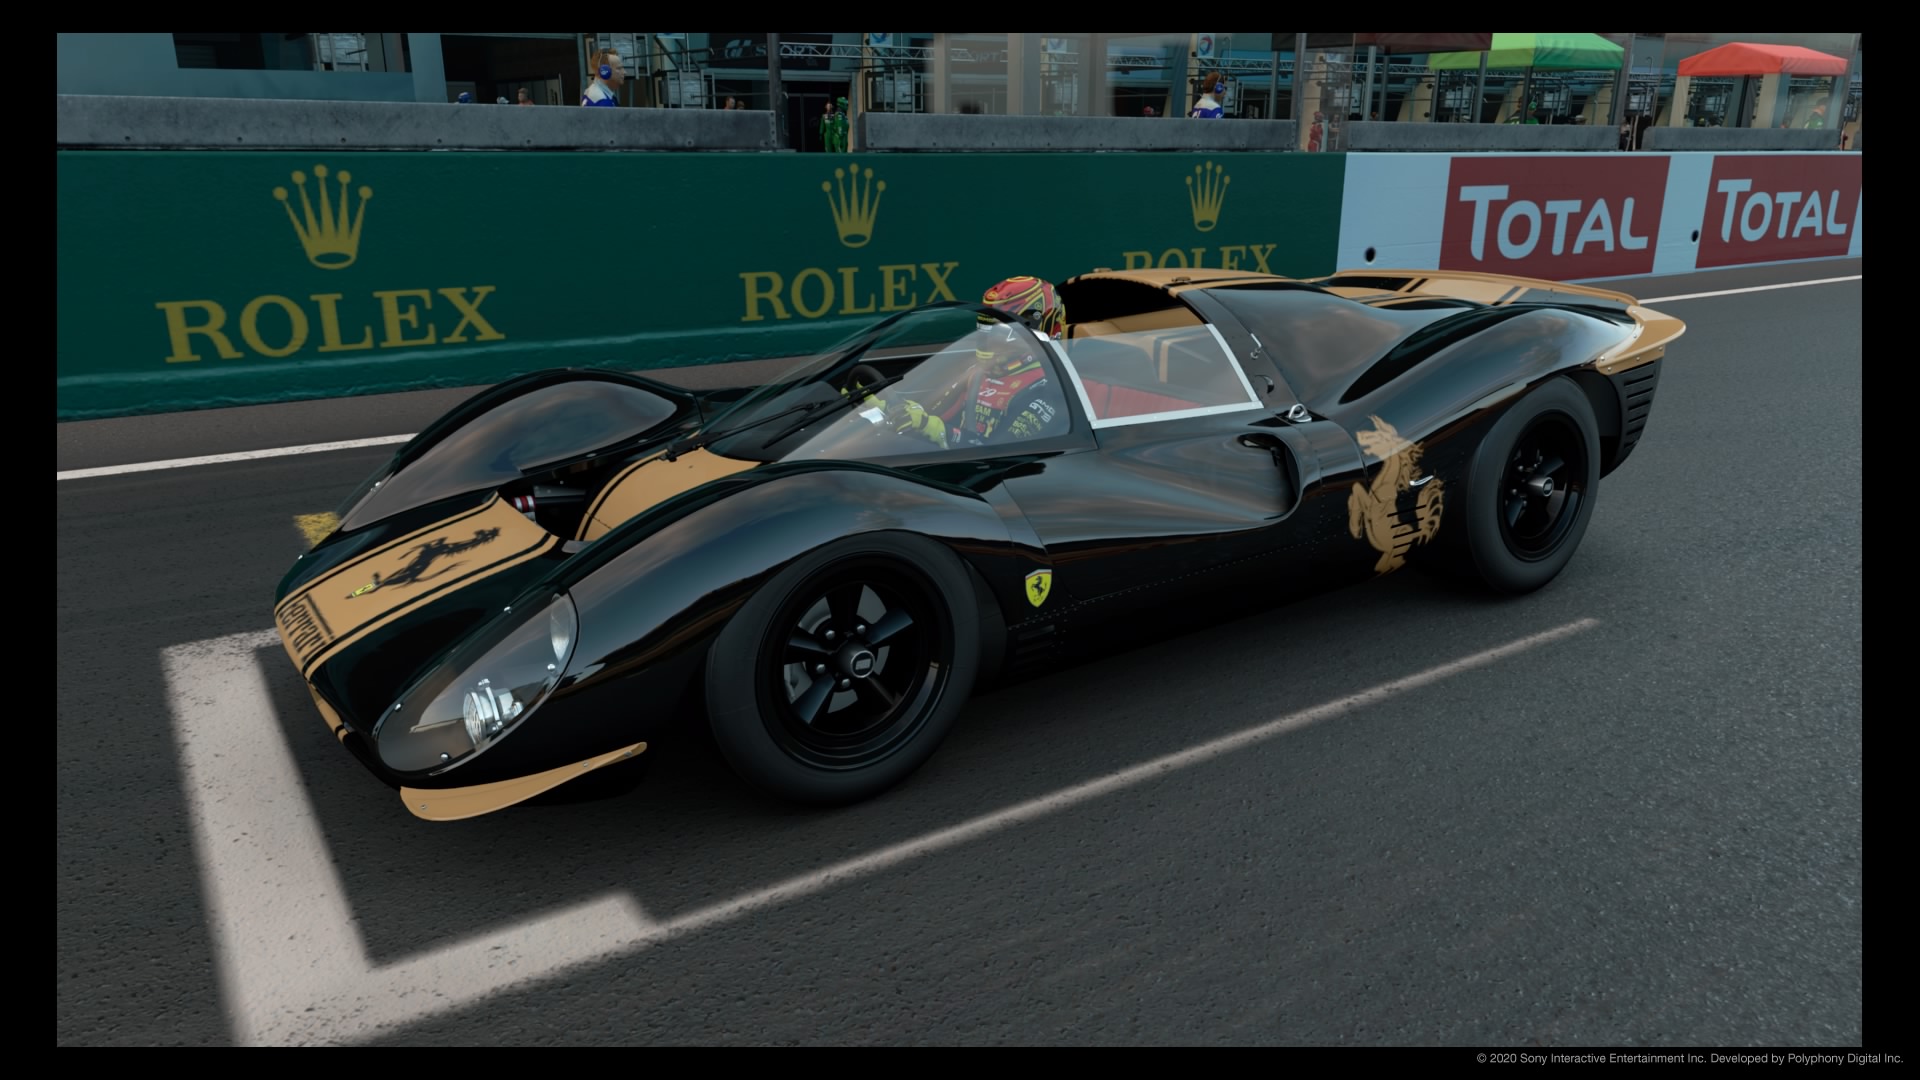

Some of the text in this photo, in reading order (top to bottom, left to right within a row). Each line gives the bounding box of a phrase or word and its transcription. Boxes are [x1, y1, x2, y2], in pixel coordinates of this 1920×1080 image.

[754, 43, 818, 59] SORT
[1459, 185, 1649, 261] TOTAL
[1717, 179, 1847, 243] TOTAL
[739, 261, 960, 322] ROLEX
[155, 286, 507, 364] ROLEX
[975, 404, 991, 417] EAM
